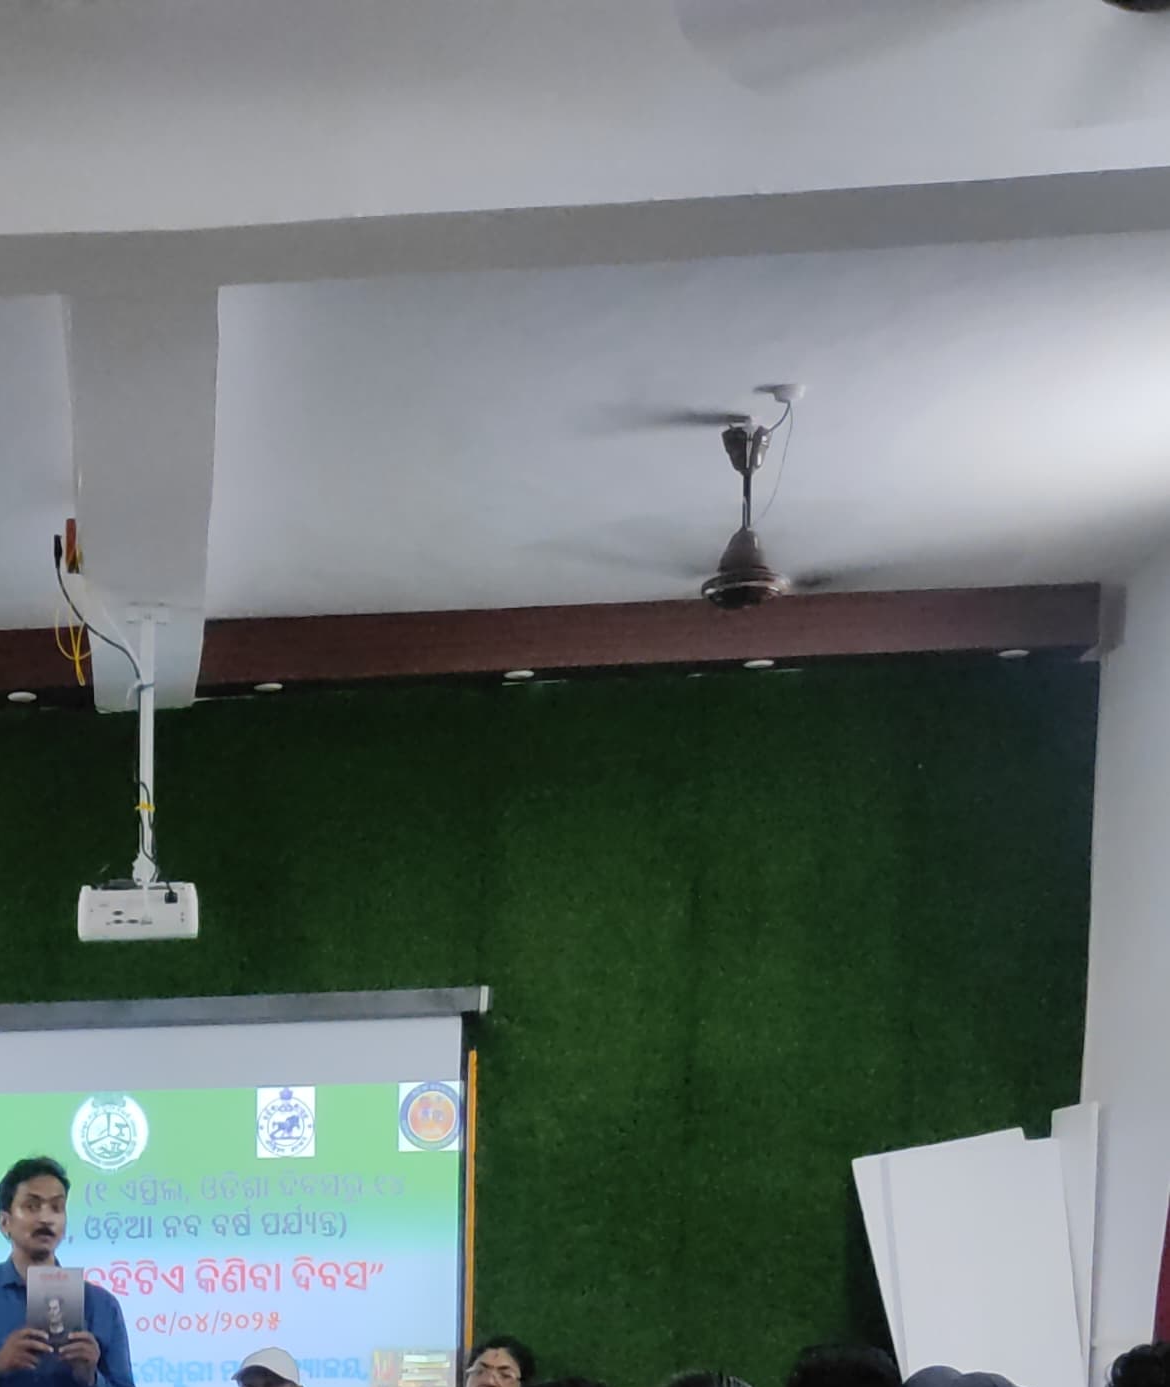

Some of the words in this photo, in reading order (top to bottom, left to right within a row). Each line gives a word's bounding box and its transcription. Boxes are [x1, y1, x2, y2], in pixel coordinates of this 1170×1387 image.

[84, 1211, 152, 1245] ଓଡ଼ିଆ
[162, 1214, 202, 1238] ନବ
[211, 1205, 251, 1237] ବର୍ଷ
[195, 1257, 281, 1294] କିଣିବା
